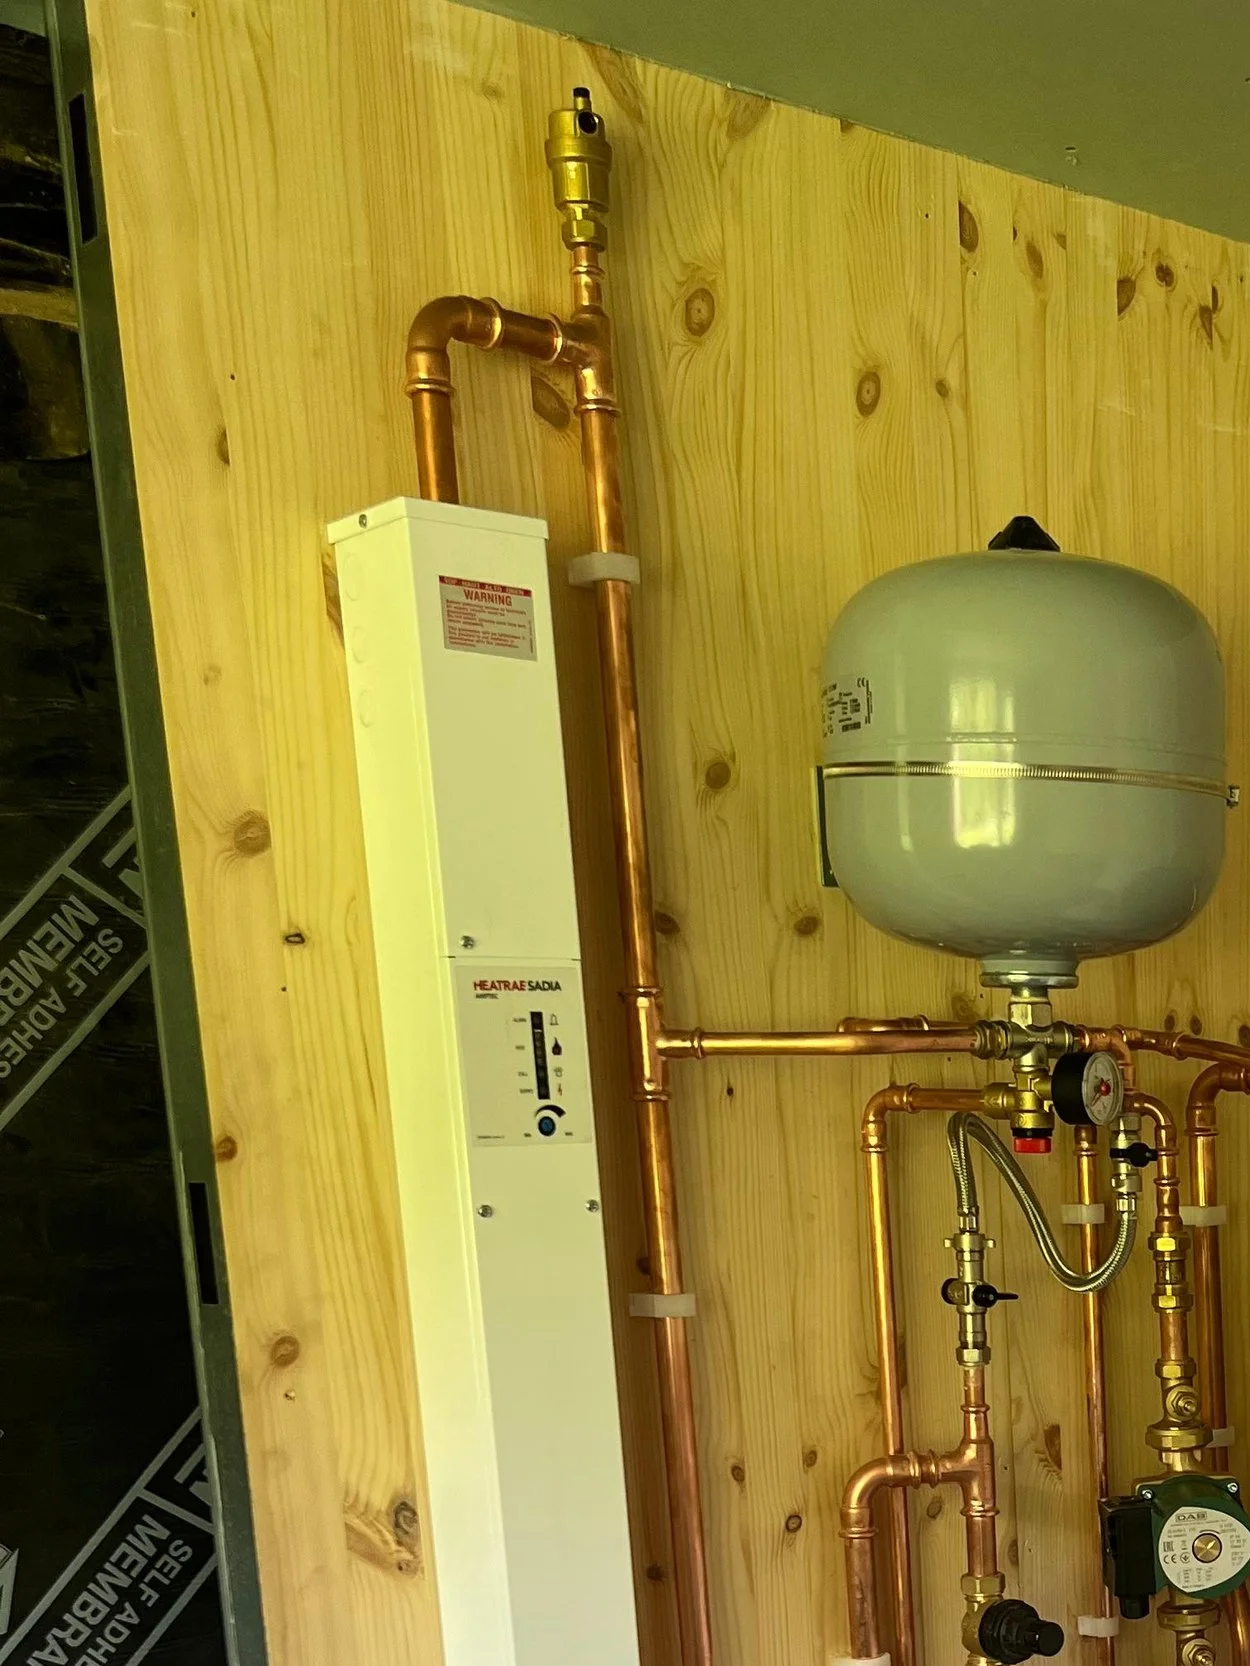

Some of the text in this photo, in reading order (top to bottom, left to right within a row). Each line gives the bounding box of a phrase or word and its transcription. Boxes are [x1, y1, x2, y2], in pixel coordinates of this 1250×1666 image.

[464, 589, 512, 606] WARNING
[66, 928, 124, 998] SELF
[473, 980, 562, 991] HEATRAE SADIA
[1177, 1512, 1206, 1520] DAB
[139, 1538, 194, 1609] SELF
